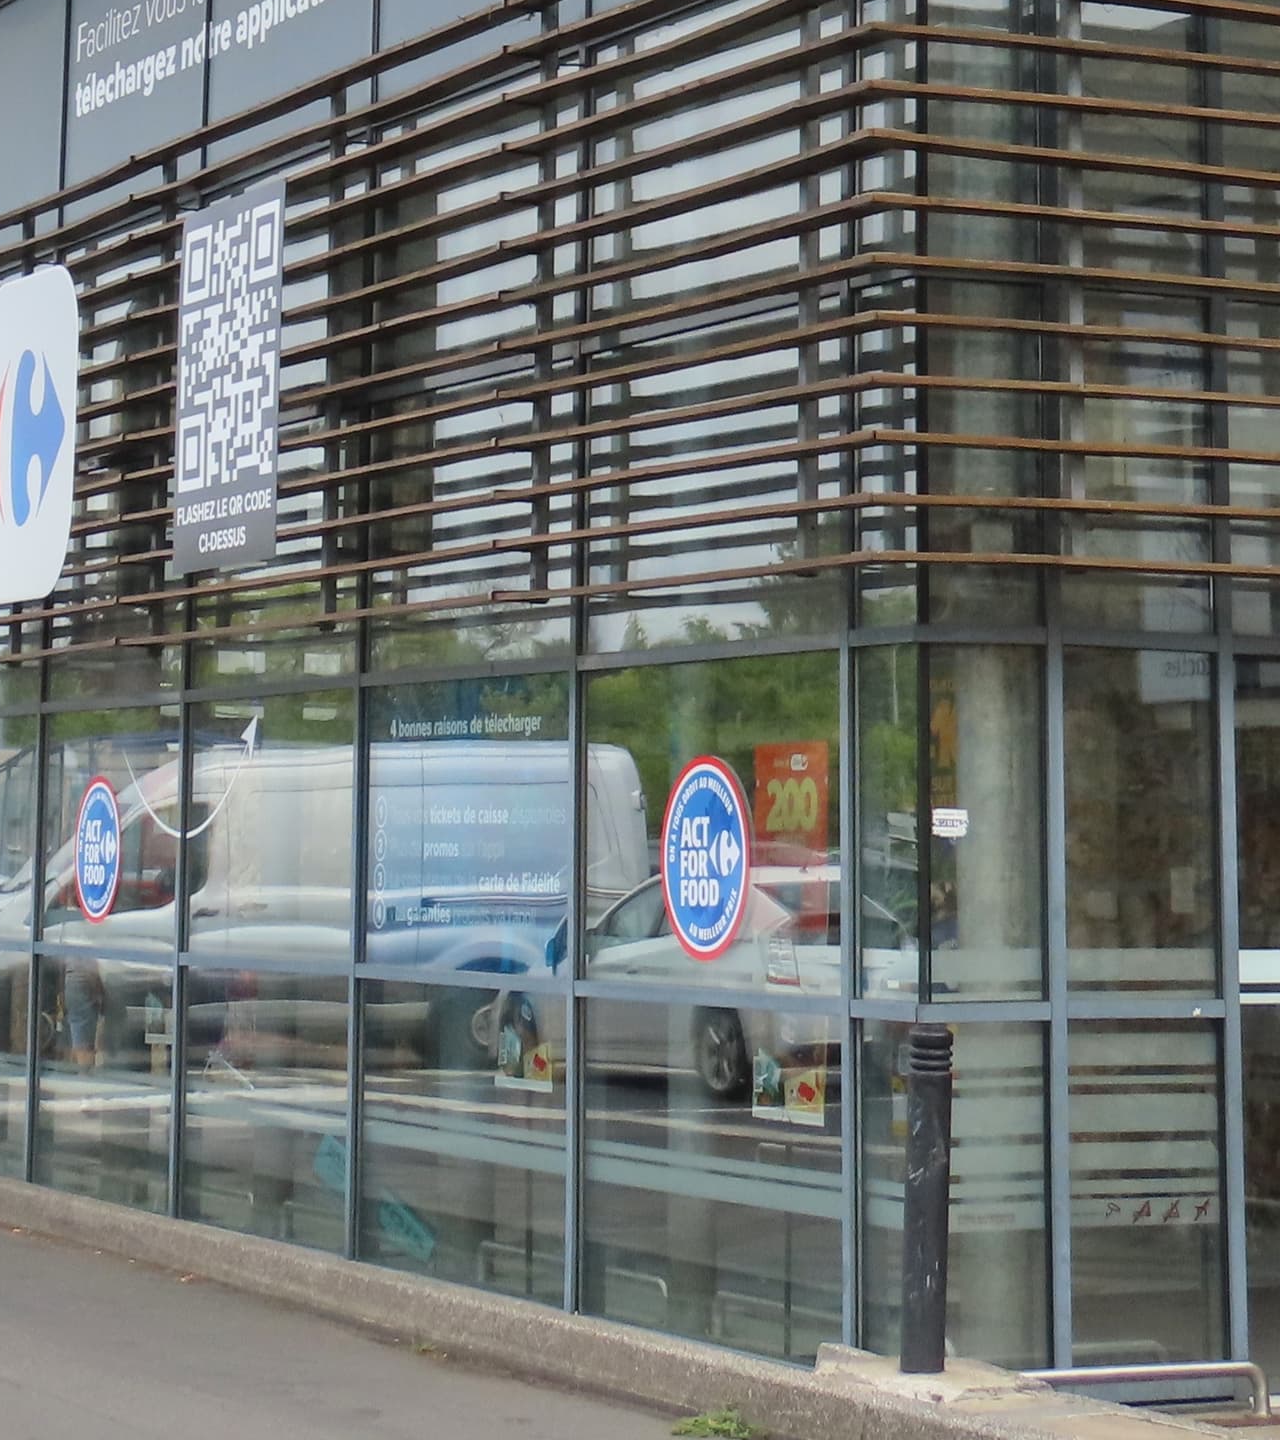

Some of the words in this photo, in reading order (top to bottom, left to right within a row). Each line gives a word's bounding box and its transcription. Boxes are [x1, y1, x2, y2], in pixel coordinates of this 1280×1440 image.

[76, 3, 142, 62] Facilitez
[75, 43, 176, 117] télechargez
[176, 500, 216, 527] FLASHEZ
[216, 497, 229, 518] LE
[229, 494, 243, 516] QR
[244, 488, 272, 512] CODE
[198, 526, 247, 553] CI-DESSUS
[399, 718, 432, 737] bonnes
[434, 715, 468, 735] raisons
[470, 715, 482, 734] de
[484, 713, 542, 736] télecharger
[682, 779, 698, 804] DROIT
[698, 777, 708, 789] AU
[708, 776, 734, 816] MEILLEUR
[430, 804, 462, 824] tickets
[463, 804, 476, 824] de
[478, 804, 509, 824] caisse
[672, 801, 684, 830] TOUS
[766, 777, 818, 832] 200
[85, 820, 102, 843] ACT
[680, 816, 710, 848] ACT
[84, 844, 100, 863] FOR
[423, 841, 459, 858] promos
[669, 845, 676, 863] ON
[83, 865, 106, 886] FOOD
[680, 849, 708, 877] FOR
[479, 874, 504, 892] carte
[506, 871, 519, 892] de
[680, 879, 719, 907] FOOD
[407, 903, 451, 926] garanties
[698, 914, 727, 941] MEILLEUR
[725, 887, 737, 919] PRIX
